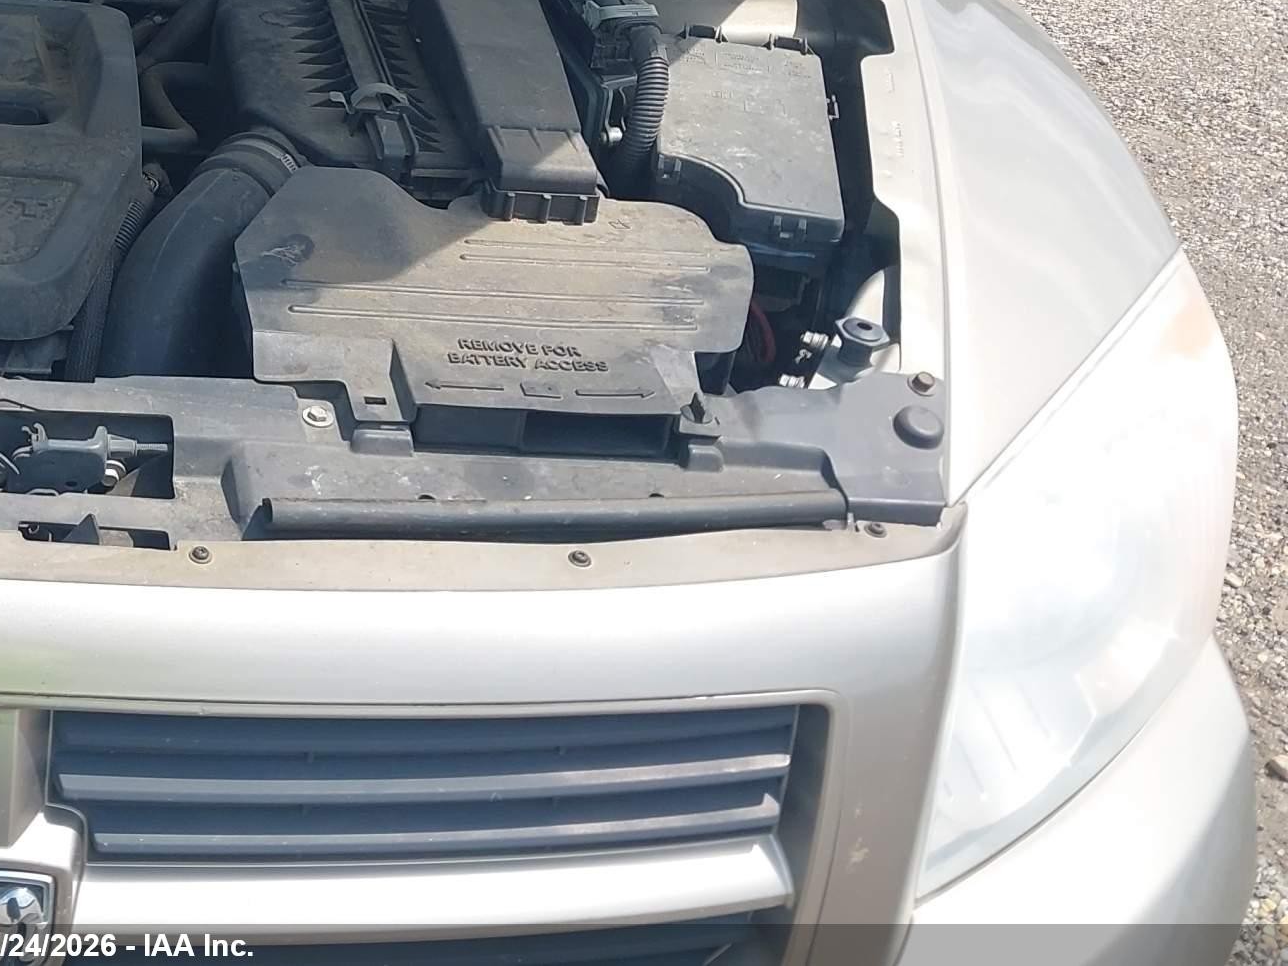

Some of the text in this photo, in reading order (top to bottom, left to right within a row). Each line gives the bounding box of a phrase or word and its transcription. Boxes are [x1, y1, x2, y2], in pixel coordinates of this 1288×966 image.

[458, 338, 582, 357] REMOVE FOR
[447, 352, 609, 372] BATTERY ACCESS
